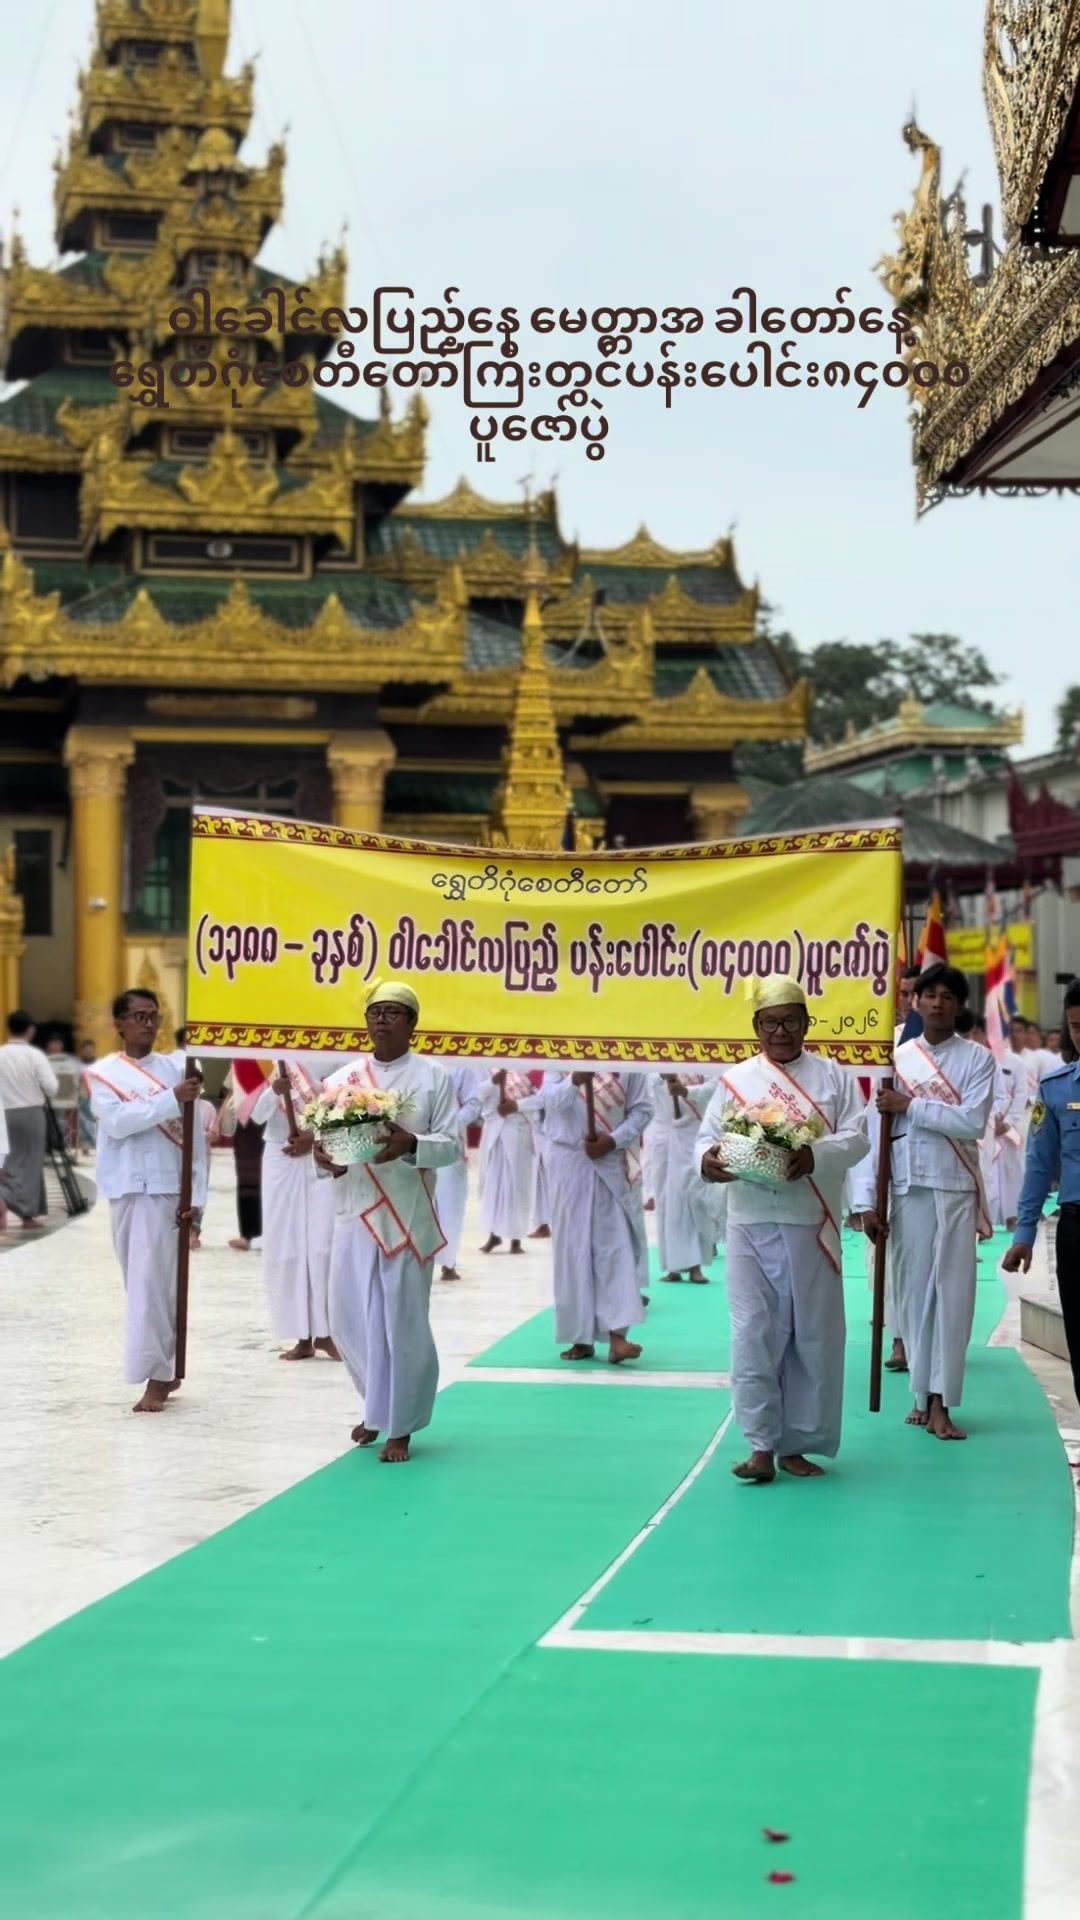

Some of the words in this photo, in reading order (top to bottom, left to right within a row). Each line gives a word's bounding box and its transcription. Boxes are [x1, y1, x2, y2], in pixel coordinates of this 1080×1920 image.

[431, 865, 648, 901] ရွှေတိဂုံစေတီတော်
